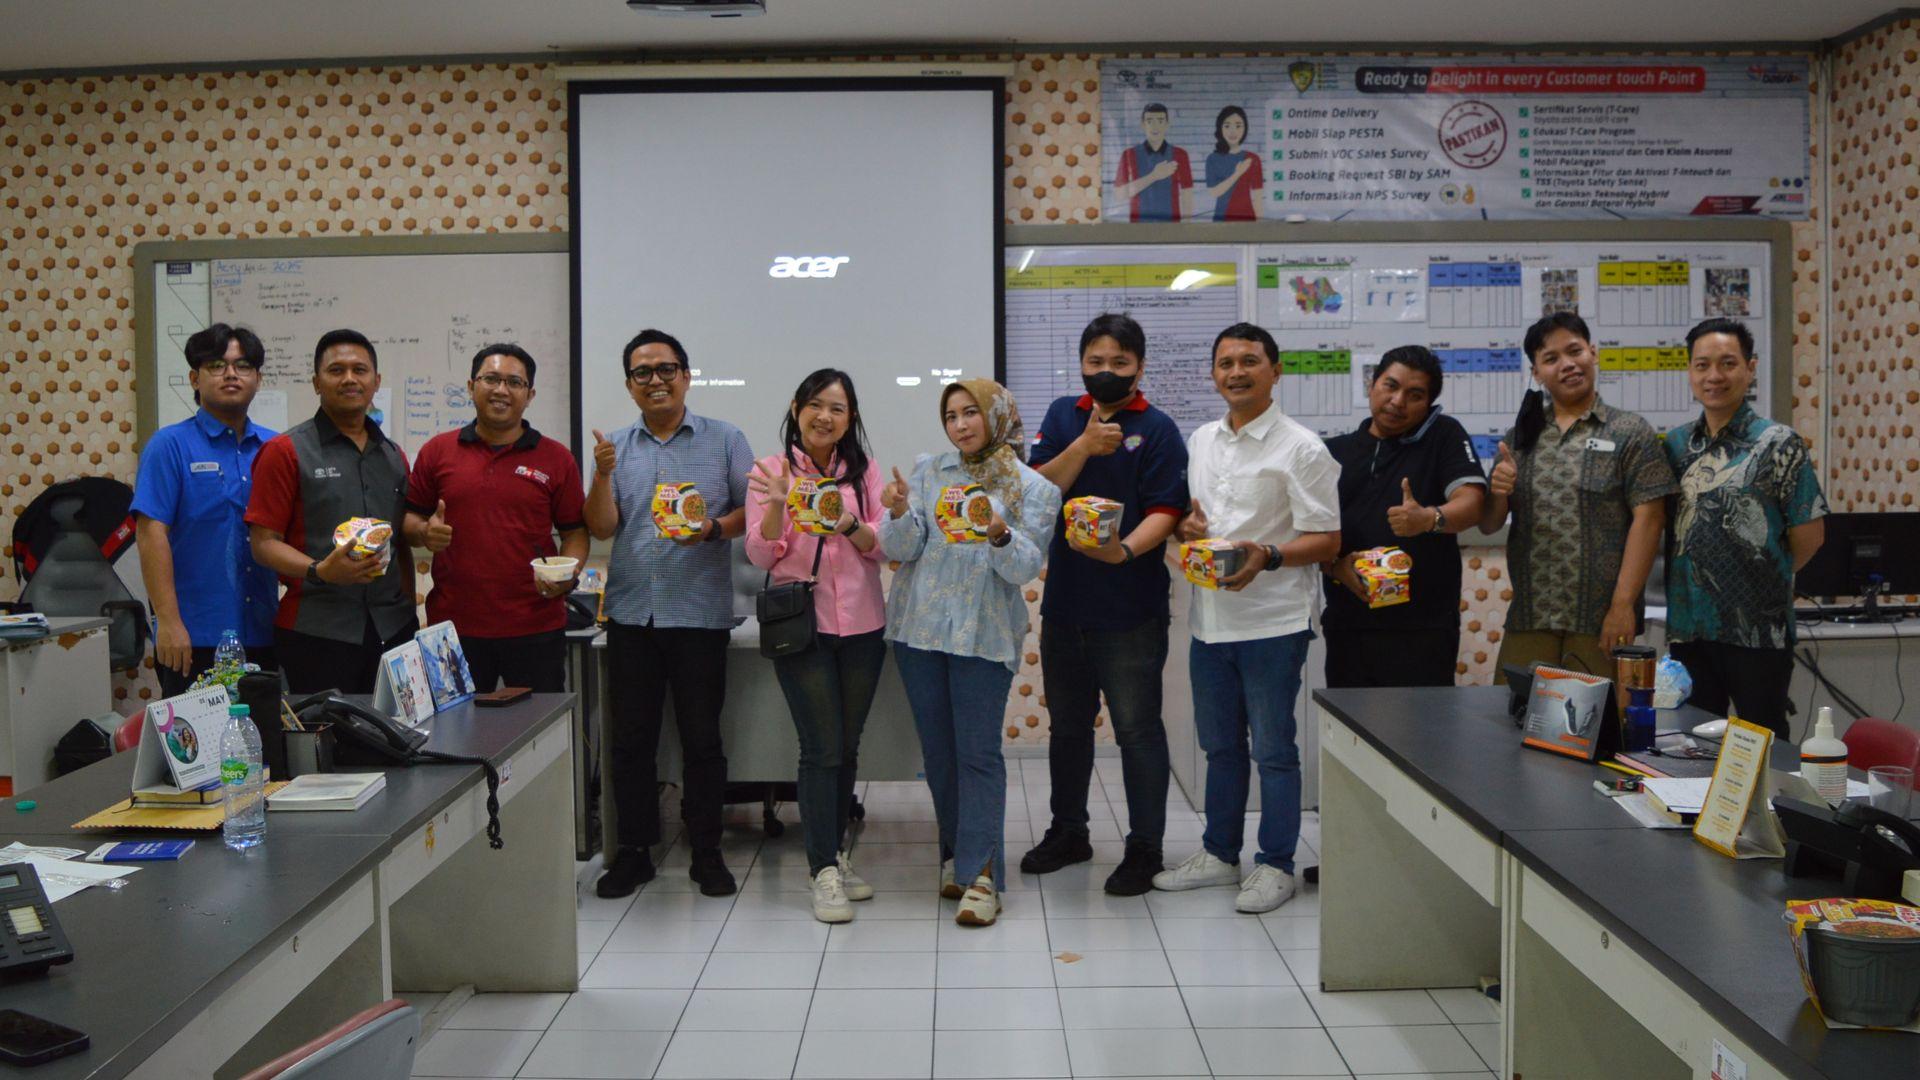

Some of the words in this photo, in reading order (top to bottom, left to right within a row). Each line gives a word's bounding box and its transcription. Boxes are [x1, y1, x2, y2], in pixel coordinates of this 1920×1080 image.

[1364, 71, 1408, 88] Ready
[1412, 71, 1428, 86] to
[1430, 71, 1482, 87] Delight
[1486, 71, 1499, 86] in
[1503, 74, 1543, 88] every
[1547, 71, 1613, 86] Customer
[1616, 71, 1655, 86] touch
[1659, 71, 1697, 86] Point
[1288, 108, 1328, 118] Ontime
[1331, 108, 1379, 119] Delivery
[1533, 105, 1574, 114] Sertifikat
[1577, 105, 1603, 114] Servis
[1288, 128, 1319, 138] Mobil
[1321, 128, 1346, 140] Siap
[1349, 128, 1384, 138] PESTA
[1444, 118, 1500, 151] PASTIKAN
[1533, 127, 1567, 135] Edukasi
[1570, 127, 1597, 135] T-Care
[1599, 127, 1636, 137] Program
[1288, 149, 1328, 159] Submit
[1331, 149, 1353, 159] VOC
[1357, 148, 1386, 158] Sales
[1391, 148, 1430, 160] Survey
[1533, 148, 1591, 157] Informasikan
[1626, 148, 1643, 157] dan
[1694, 148, 1733, 157] Asuransi
[1533, 158, 1557, 166] Mobil
[1559, 158, 1606, 168] Pelanggan
[1289, 170, 1334, 181] Booking
[1338, 170, 1384, 181] Request
[1409, 169, 1424, 181] by
[1427, 169, 1451, 178] SAM
[1534, 168, 1591, 177] Informasikan
[1592, 168, 1613, 176] Fitur
[1616, 168, 1632, 176] dan
[1634, 168, 1670, 176] Aktivasi
[1715, 168, 1732, 176] dan
[1553, 179, 1585, 188] (Toyota
[1587, 179, 1616, 188] Safety
[1617, 179, 1647, 188] Sense)
[1289, 190, 1362, 200] Informasikan
[1365, 190, 1389, 200] NPS
[1392, 190, 1431, 201] Survey
[1536, 190, 1592, 198] Informasikan
[1594, 190, 1637, 199] Teknologi
[1639, 190, 1670, 199] Hybrid
[1535, 200, 1552, 208] dan
[1625, 200, 1656, 209] Hybrid
[770, 256, 850, 278] acer
[208, 694, 225, 707] MAY
